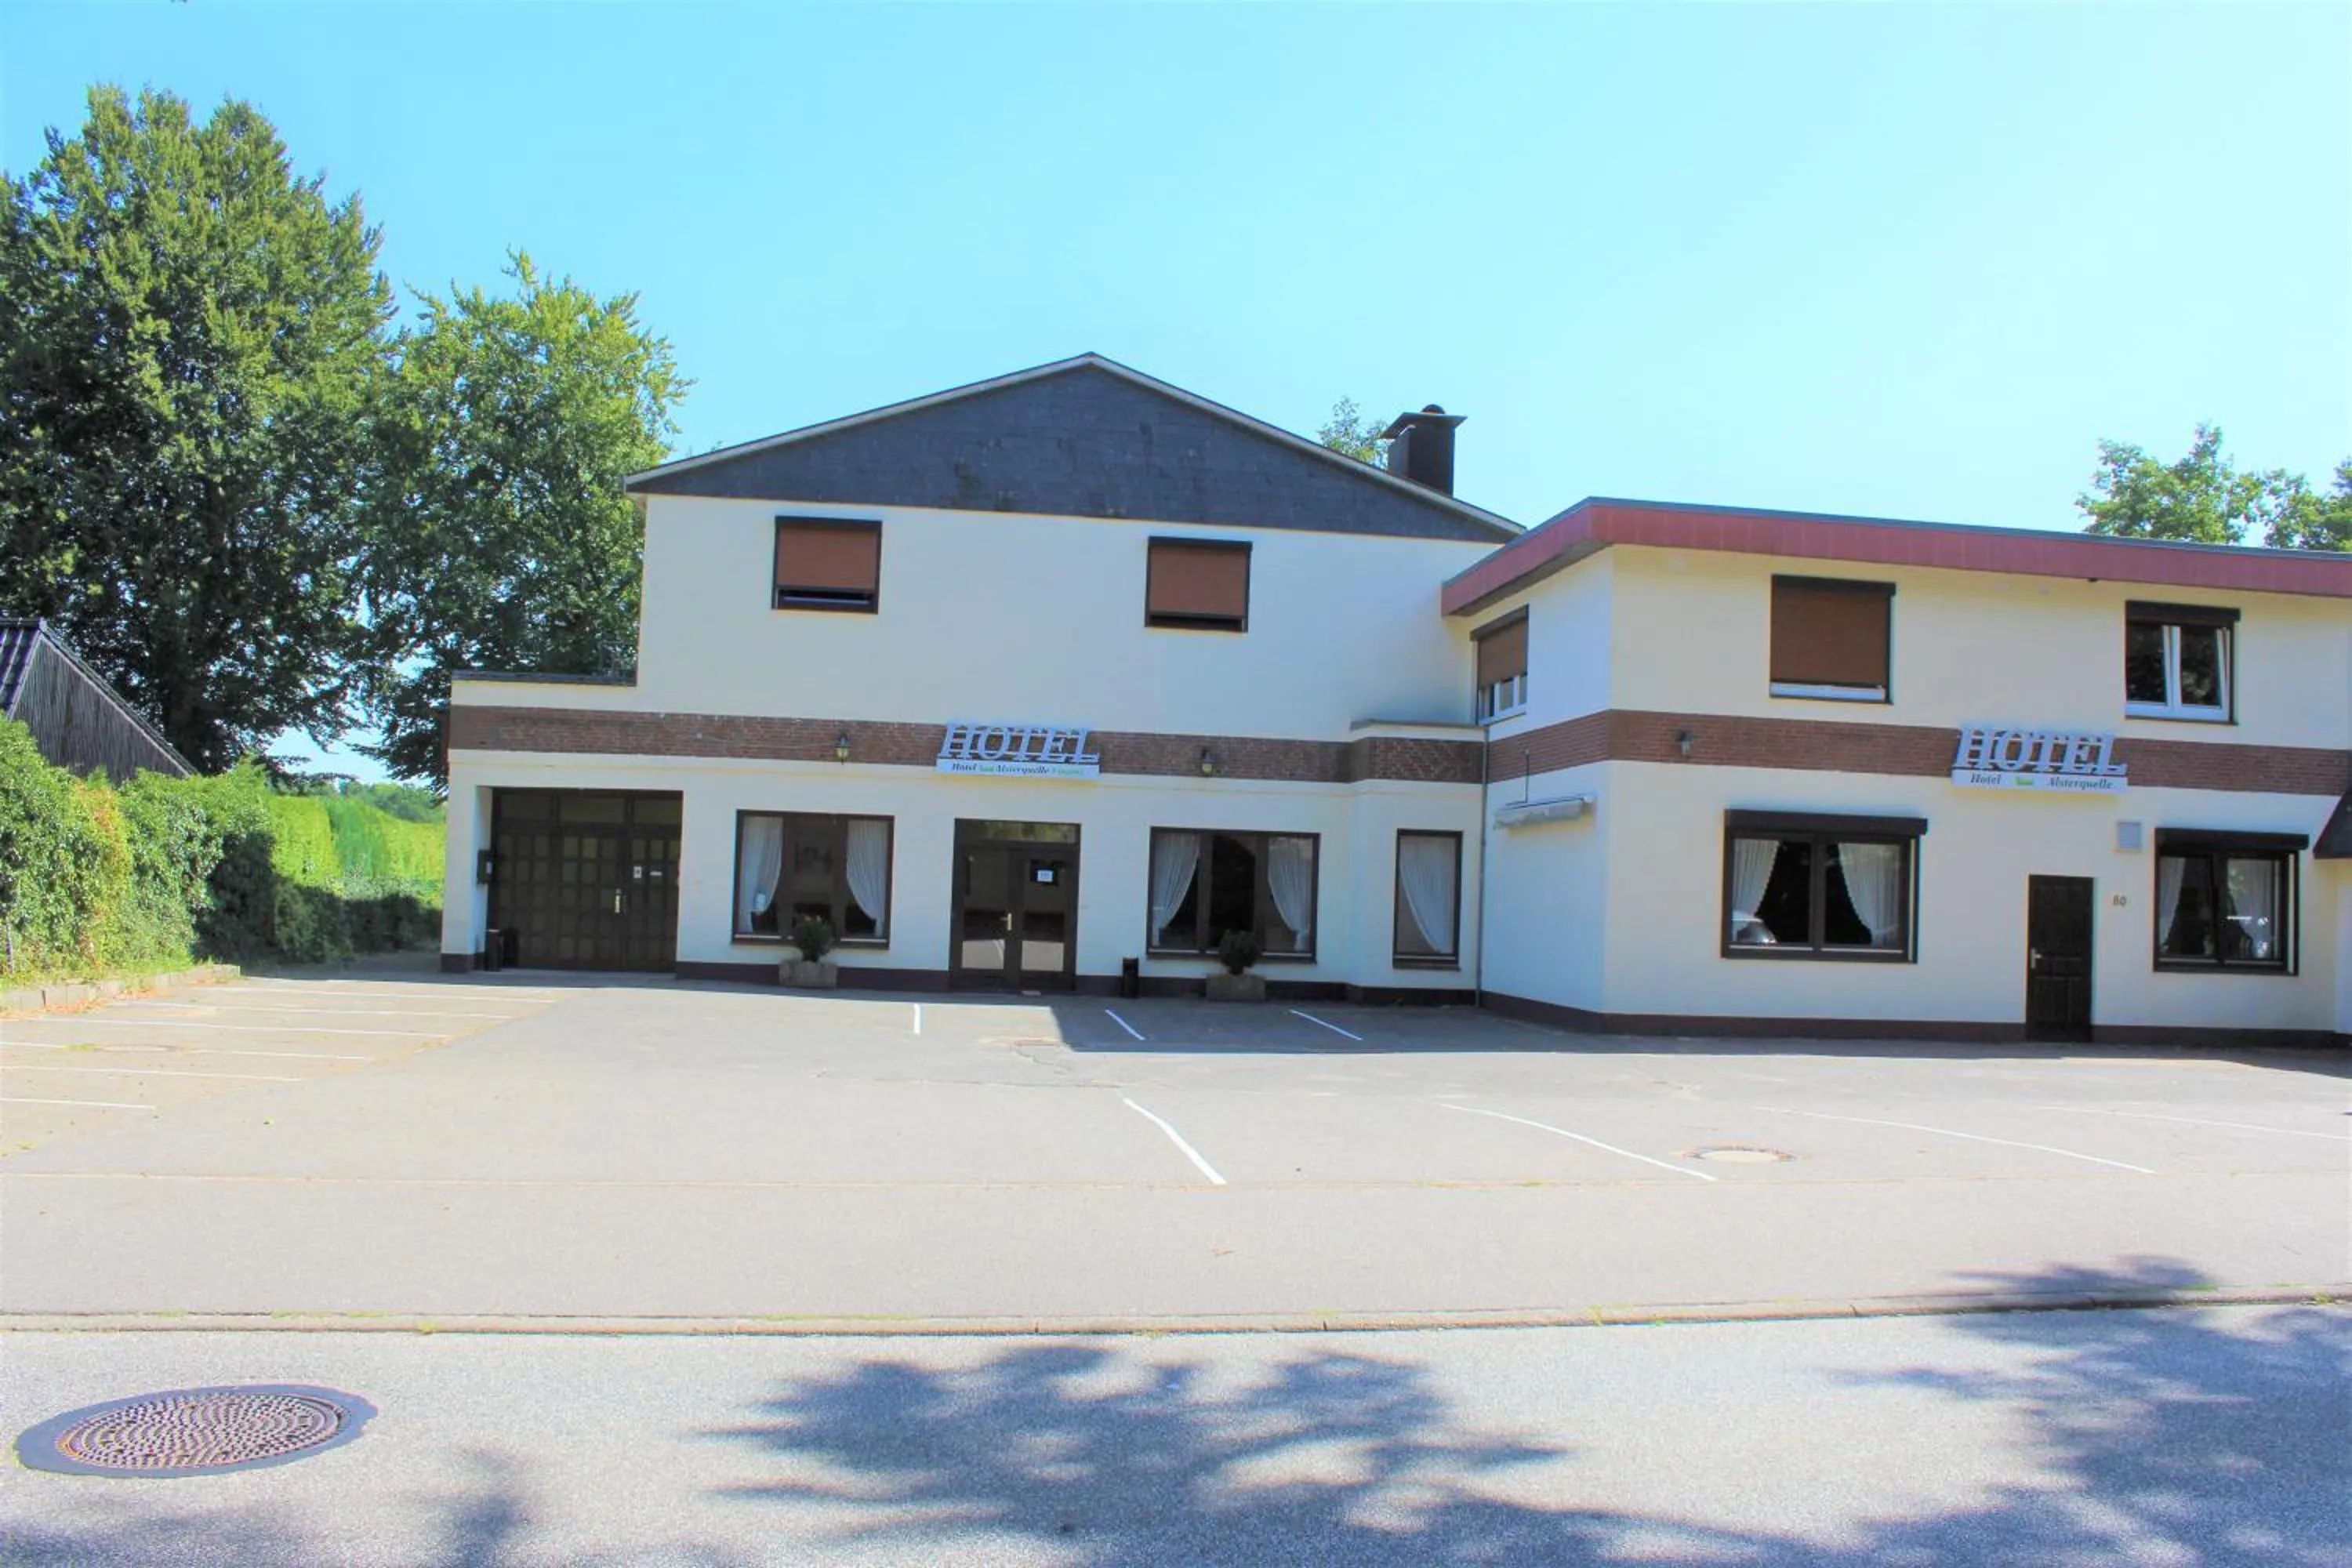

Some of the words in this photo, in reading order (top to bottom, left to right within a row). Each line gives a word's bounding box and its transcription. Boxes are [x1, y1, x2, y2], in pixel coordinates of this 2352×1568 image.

[938, 723, 1100, 763] HOTEL
[1952, 727, 2128, 775] HOTEL
[952, 763, 978, 771] Hotel
[1969, 773, 2002, 785] Hotel
[2048, 776, 2114, 790] Alsterquelle
